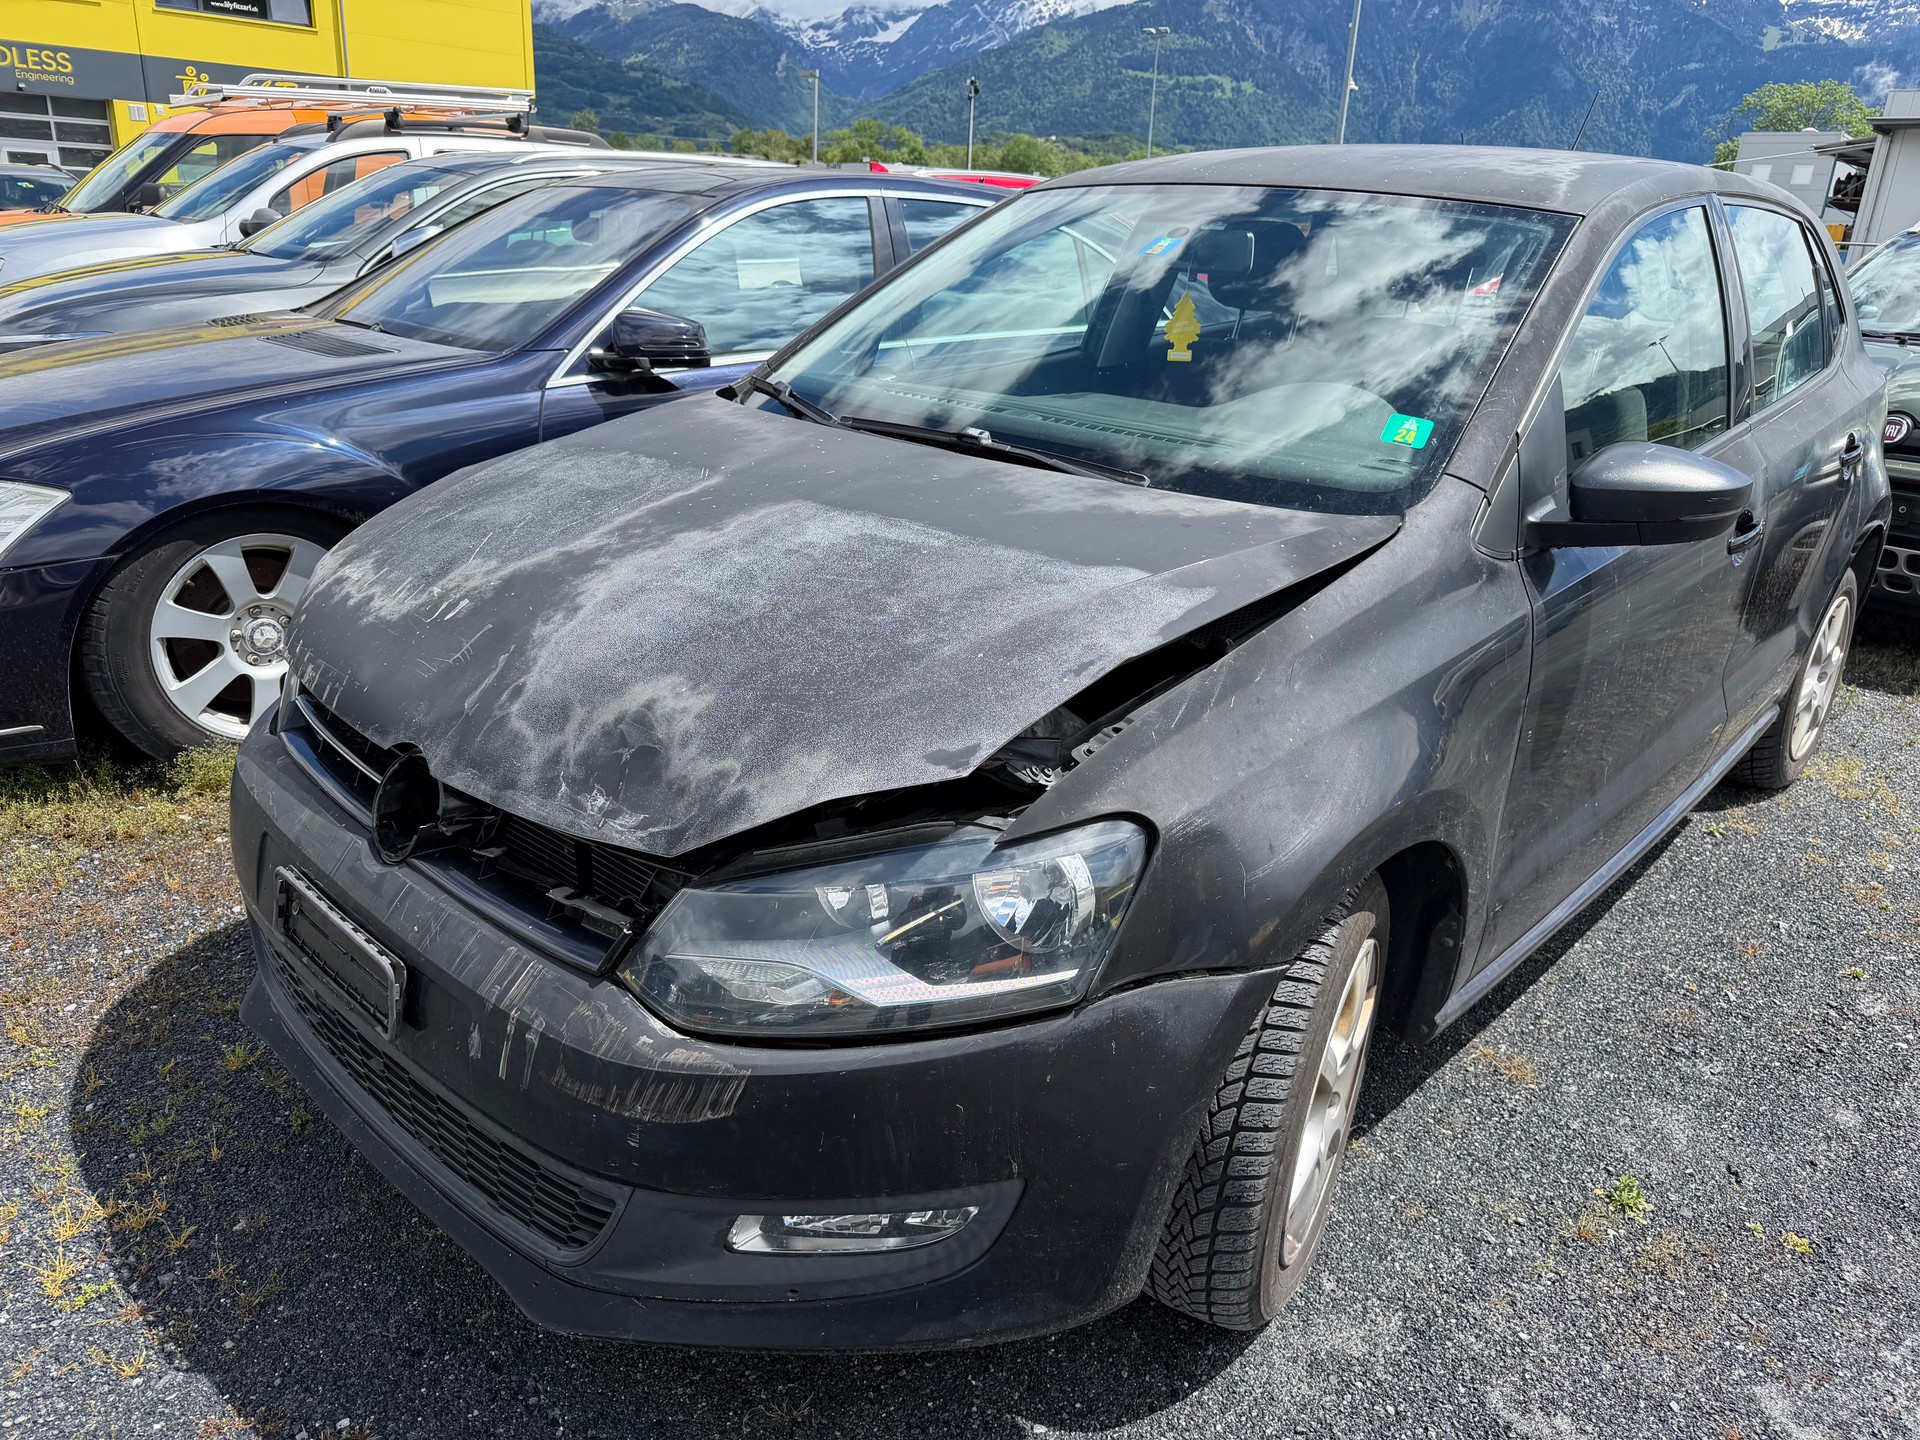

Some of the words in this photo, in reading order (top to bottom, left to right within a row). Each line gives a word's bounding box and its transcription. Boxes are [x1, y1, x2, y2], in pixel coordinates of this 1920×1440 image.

[15, 69, 75, 86] Engineering
[1394, 428, 1417, 444] 24
[1885, 424, 1901, 438] IAT
